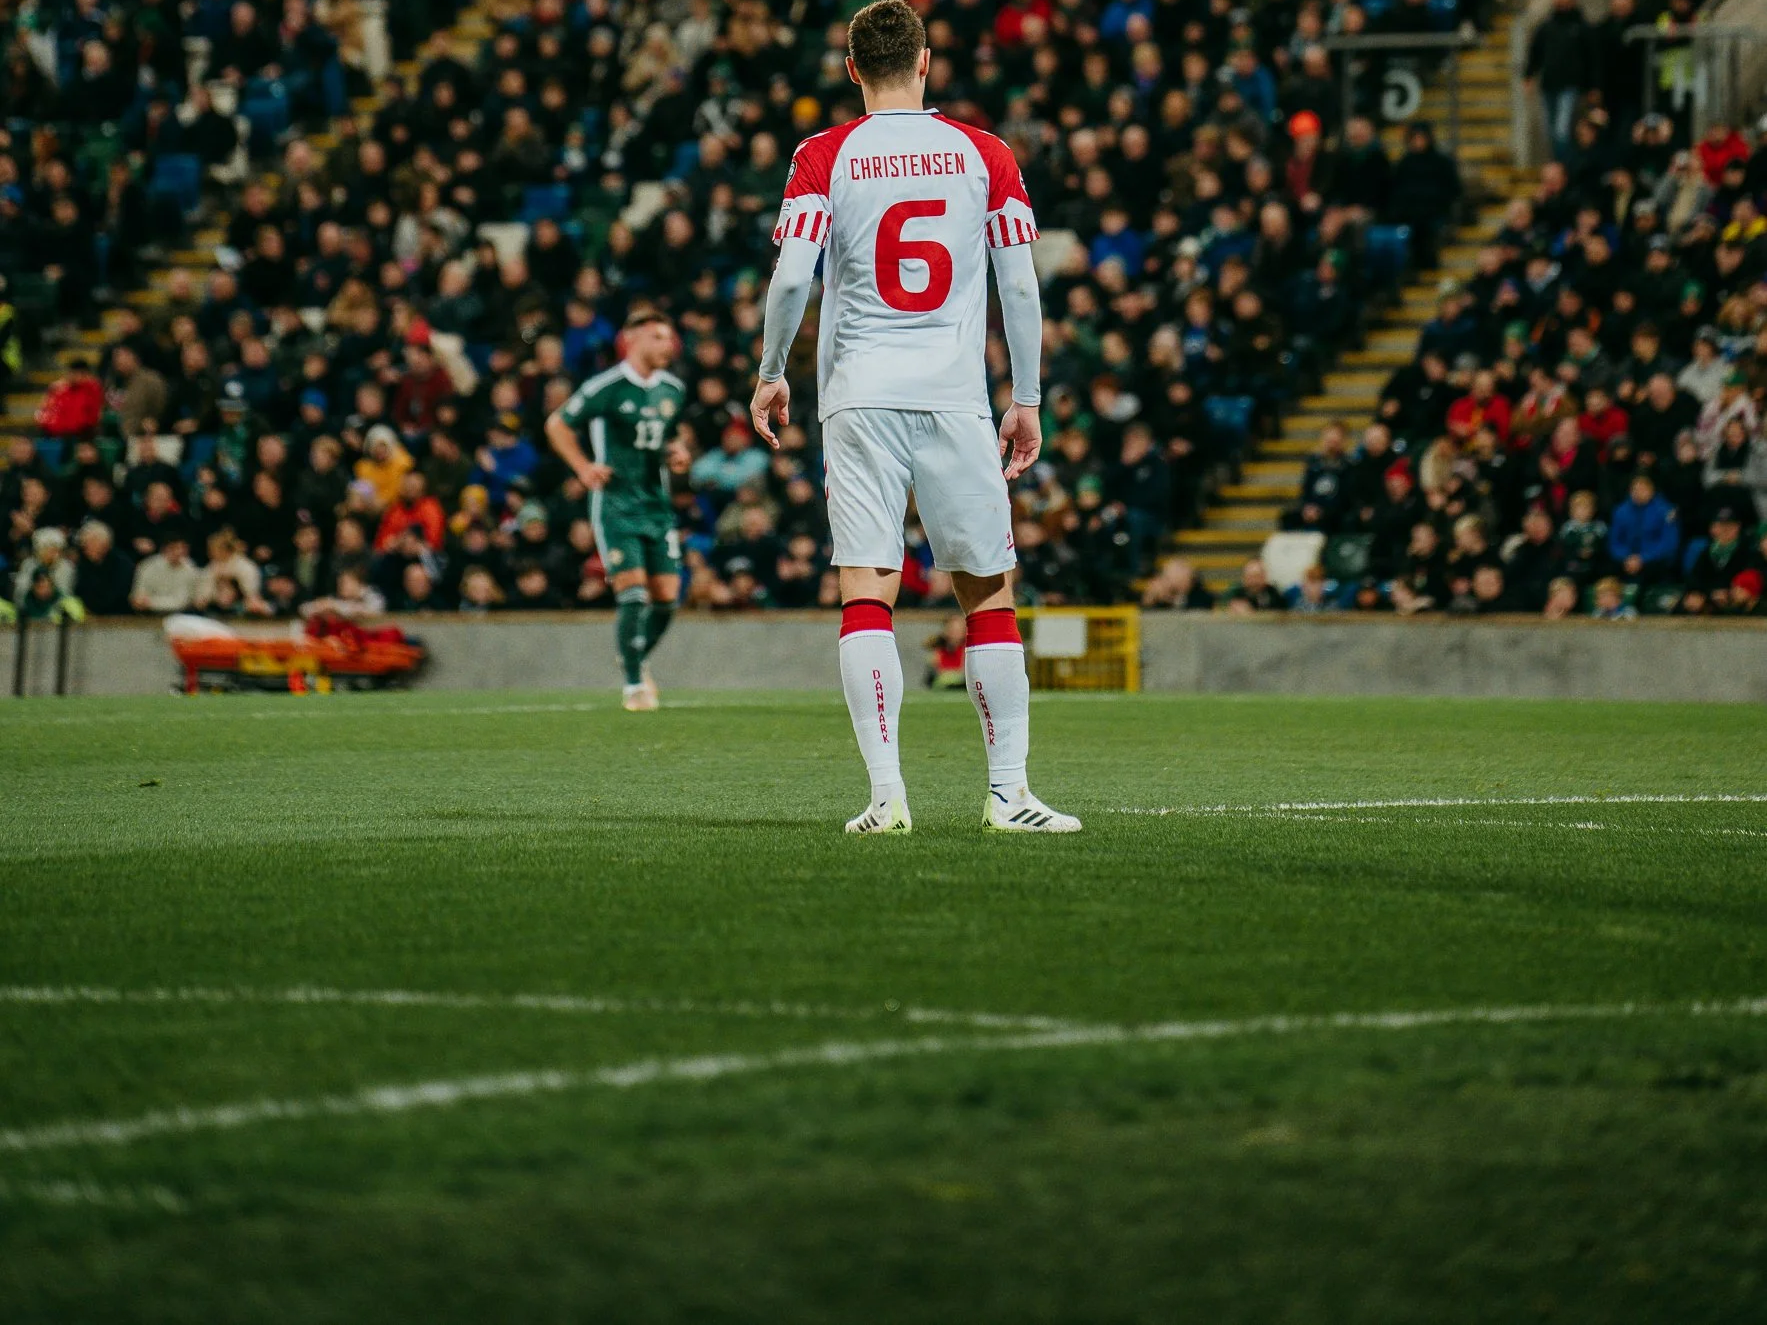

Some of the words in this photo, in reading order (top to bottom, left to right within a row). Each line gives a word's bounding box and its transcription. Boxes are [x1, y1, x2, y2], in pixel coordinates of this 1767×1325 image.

[850, 152, 966, 180] CHRISTENSEN
[875, 199, 953, 313] 6
[872, 670, 890, 743] DANMARK
[975, 681, 996, 746] DANMARK
